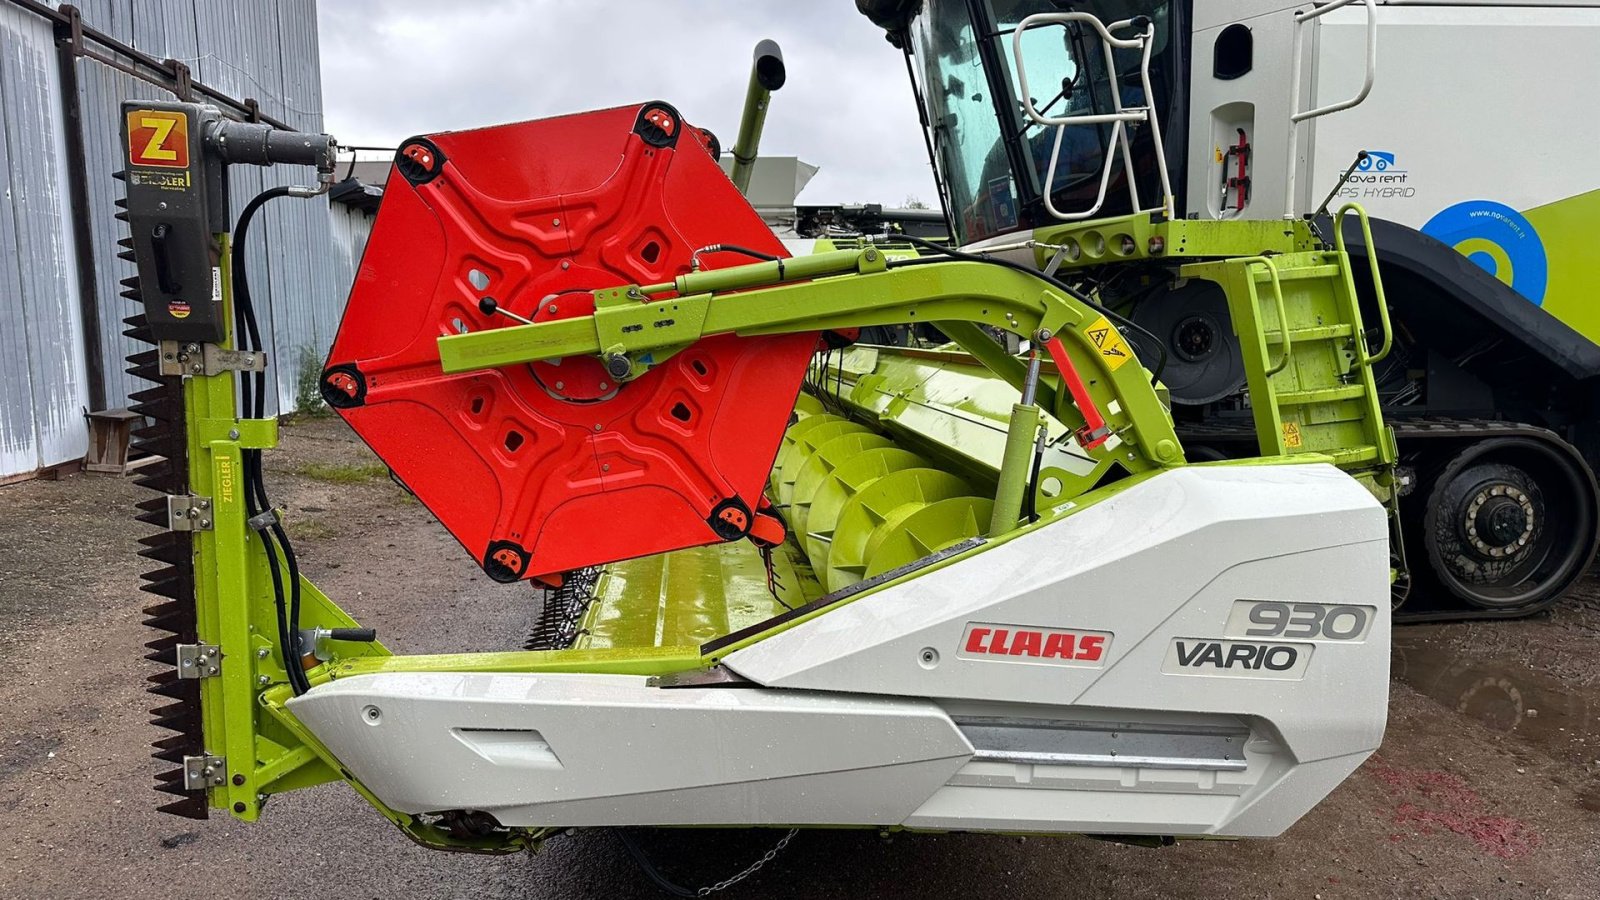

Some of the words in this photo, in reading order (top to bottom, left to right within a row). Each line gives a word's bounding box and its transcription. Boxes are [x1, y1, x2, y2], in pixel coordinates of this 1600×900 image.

[141, 117, 177, 161] Z
[1363, 187, 1416, 198] HYBRID
[1379, 173, 1408, 183] rent
[221, 461, 233, 503] ZIEGLER
[1246, 602, 1367, 640] 930
[965, 627, 1106, 662] CLAAS
[1175, 641, 1299, 672] VARIO
